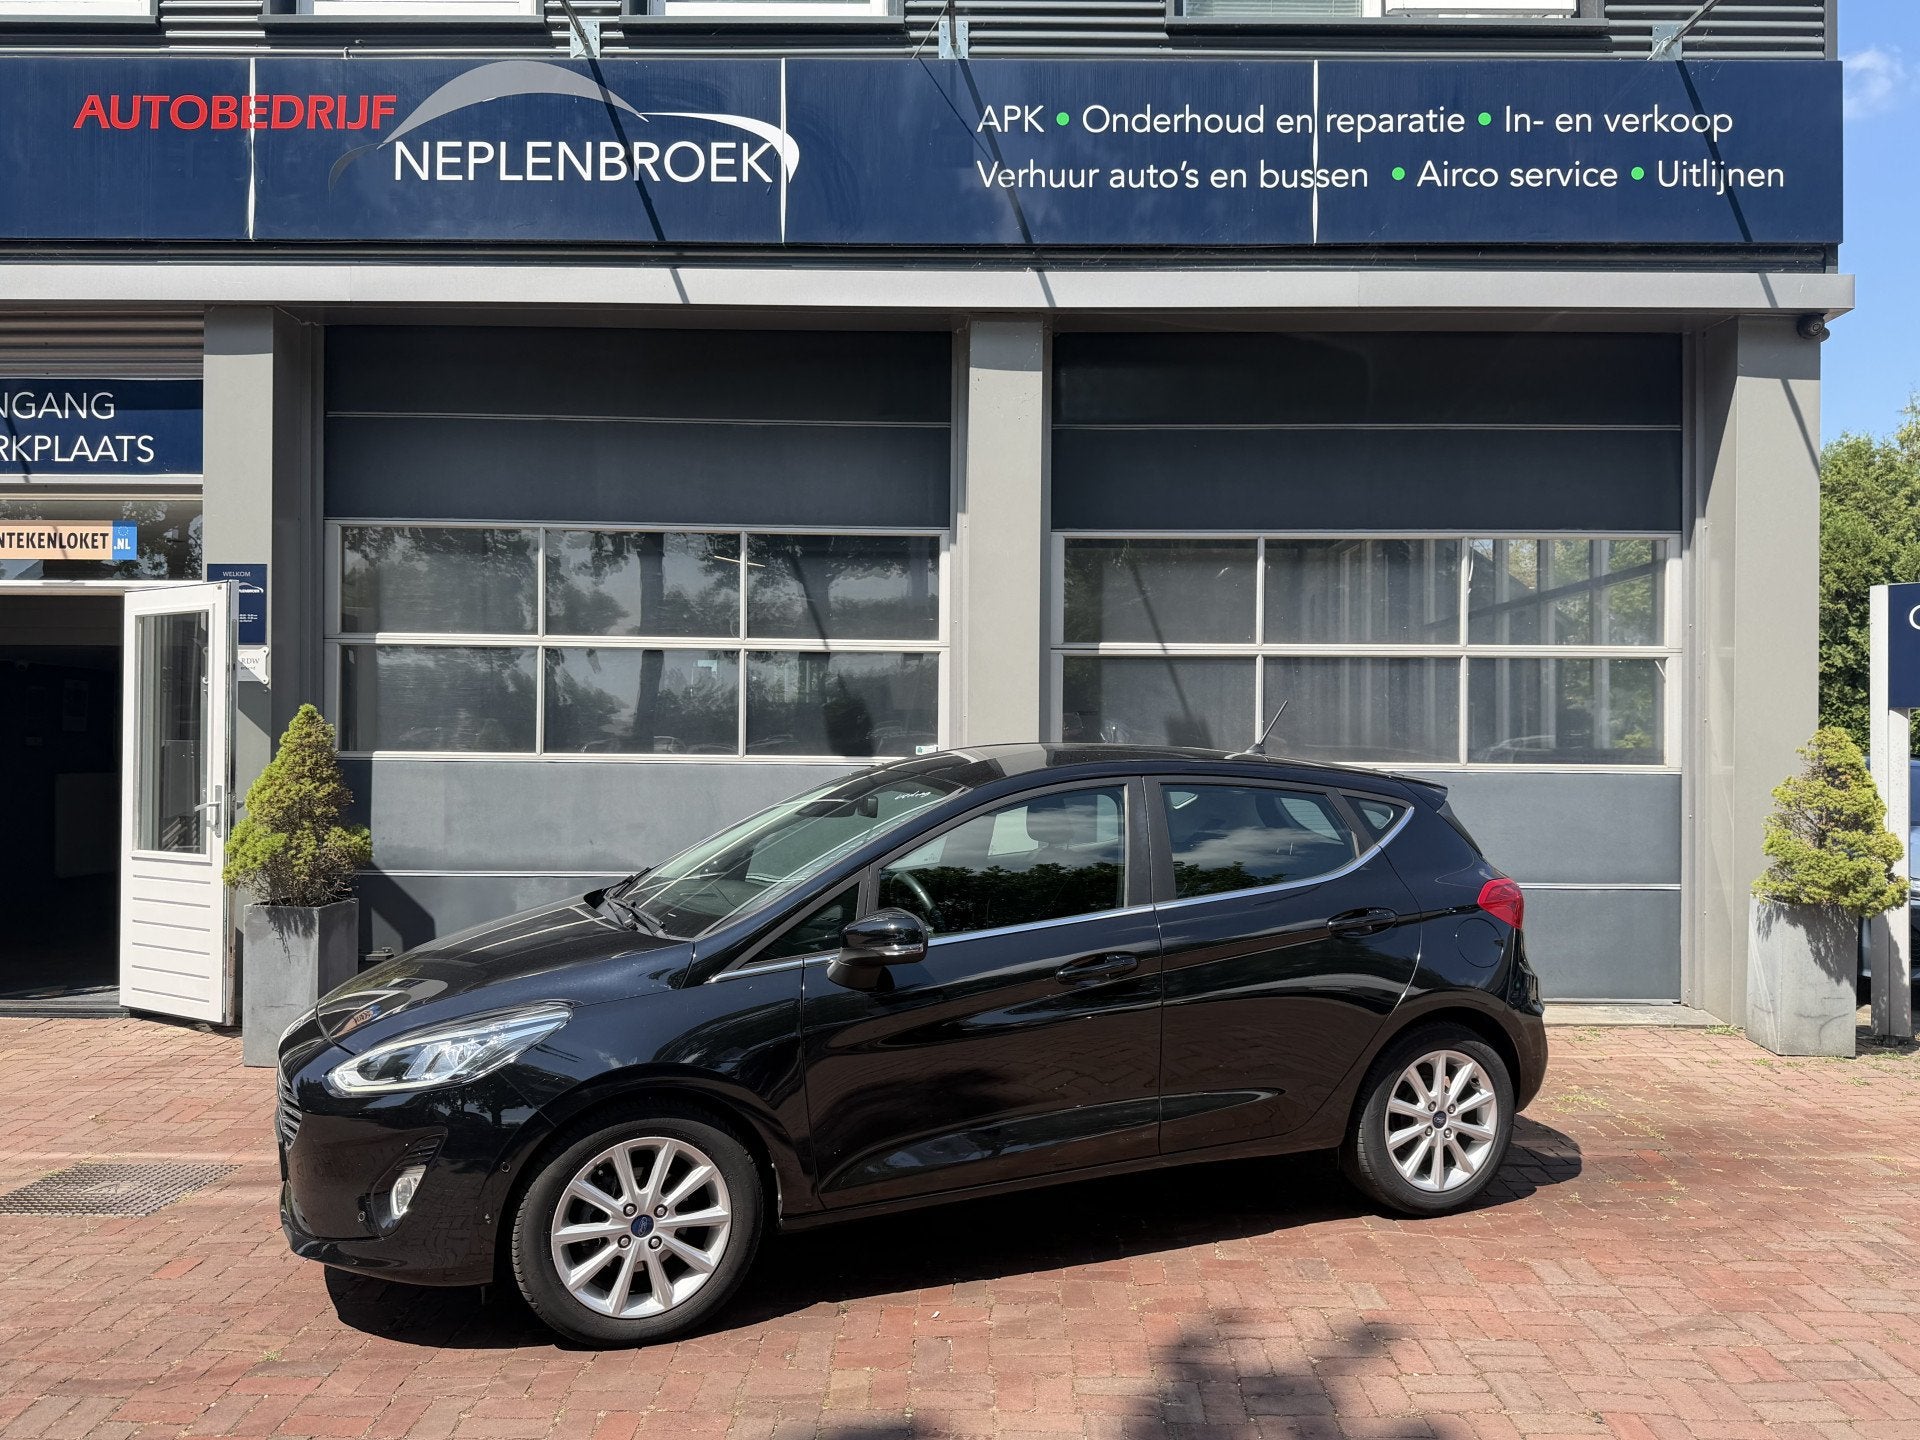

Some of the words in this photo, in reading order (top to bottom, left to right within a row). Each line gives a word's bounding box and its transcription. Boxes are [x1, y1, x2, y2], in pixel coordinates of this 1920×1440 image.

[74, 94, 397, 131] AUTOBEDRIJF
[976, 105, 1045, 133] APK
[1082, 103, 1265, 133] Onderhoud
[1276, 114, 1313, 134] en
[1326, 105, 1466, 143] reparatie
[1505, 105, 1544, 133] In-
[1555, 113, 1592, 133] en
[1603, 103, 1733, 143] verkoop
[394, 140, 773, 184] NEPLENBROEK
[976, 158, 1100, 189] Verhuur
[1109, 160, 1200, 189] auto’s
[1209, 168, 1247, 189] en
[1259, 159, 1369, 189] bussen
[1416, 159, 1499, 188] Airco
[1509, 160, 1618, 188] service
[1658, 158, 1784, 196] Uitlijnen
